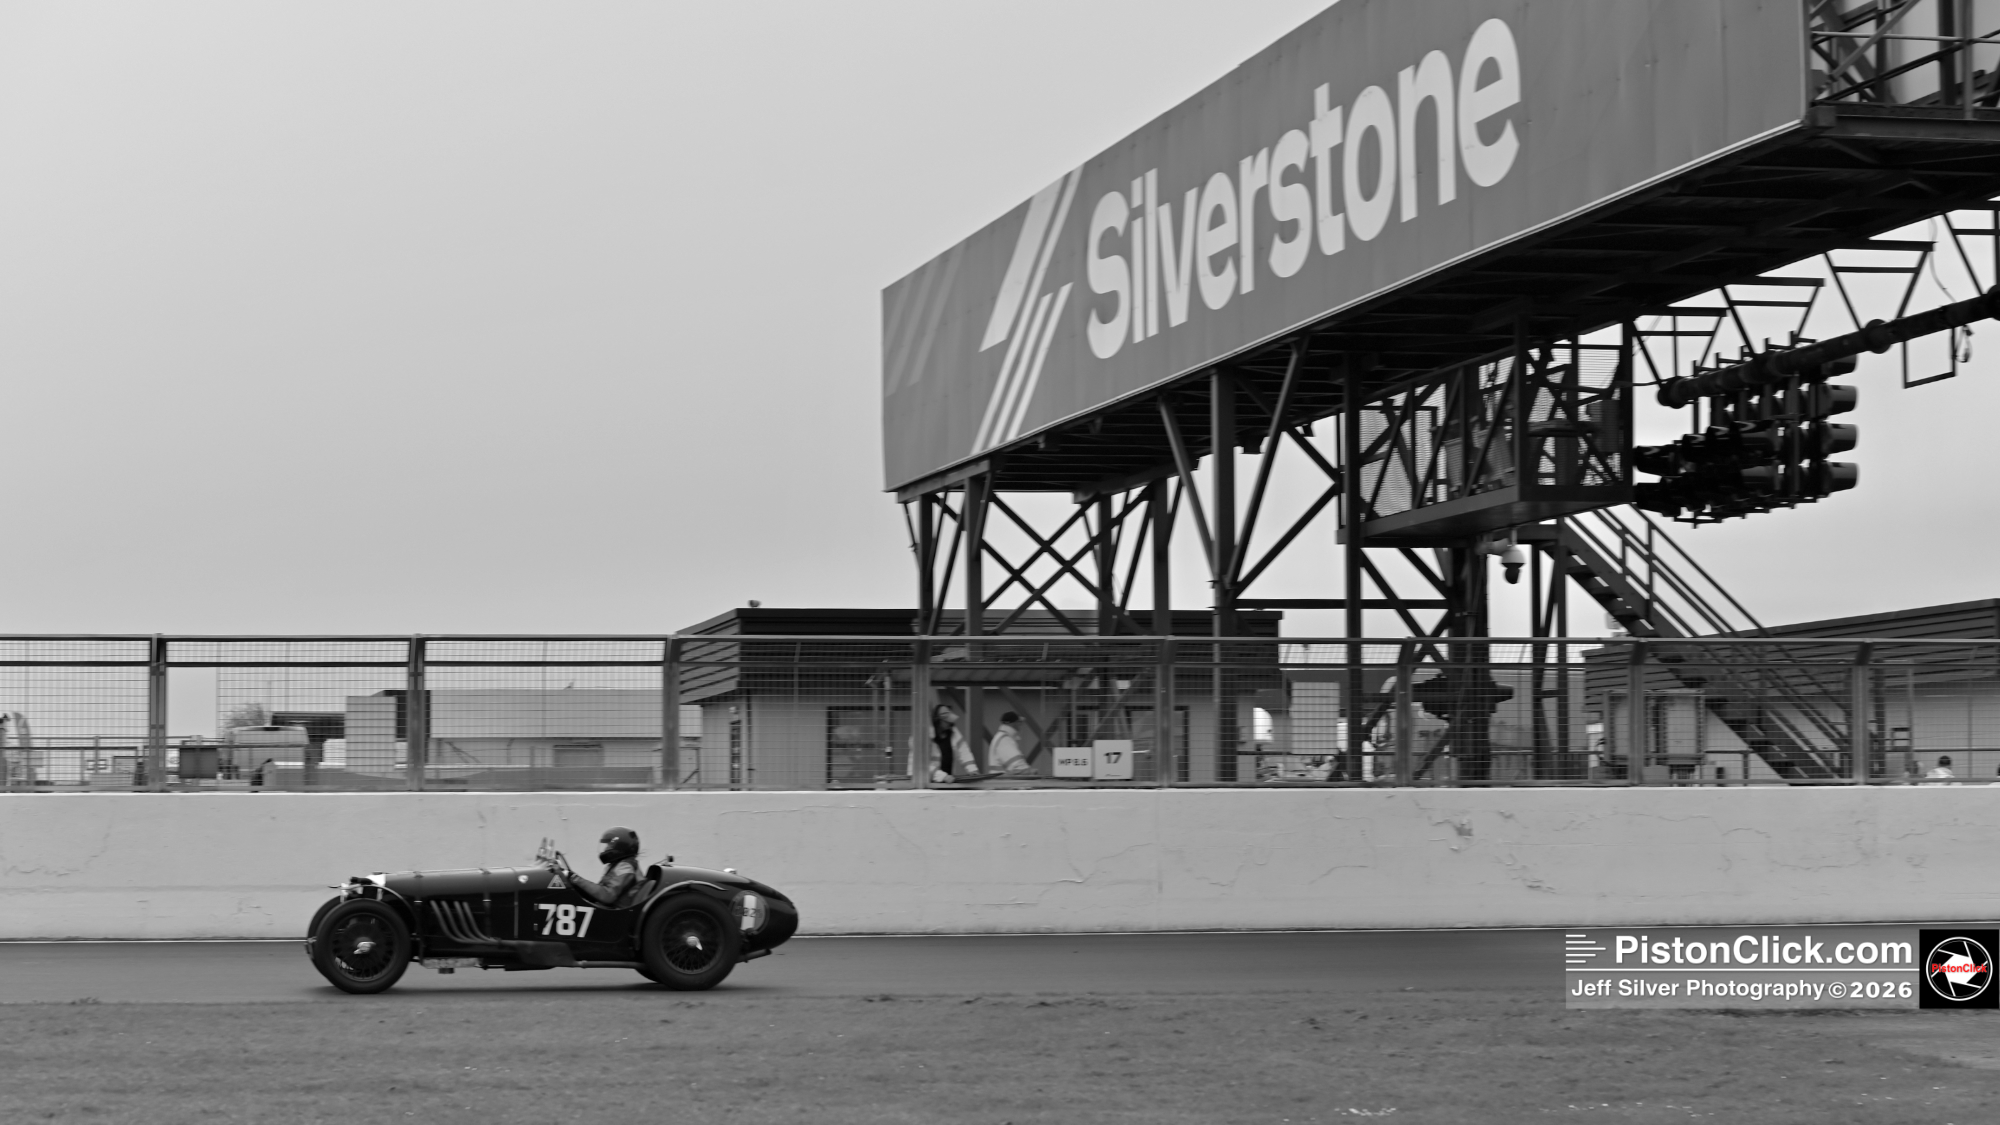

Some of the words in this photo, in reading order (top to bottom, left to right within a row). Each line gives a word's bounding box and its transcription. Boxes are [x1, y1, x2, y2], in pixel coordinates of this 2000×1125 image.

[1086, 18, 1522, 360] Silverstone
[1104, 752, 1122, 764] 17
[538, 903, 596, 938] 787
